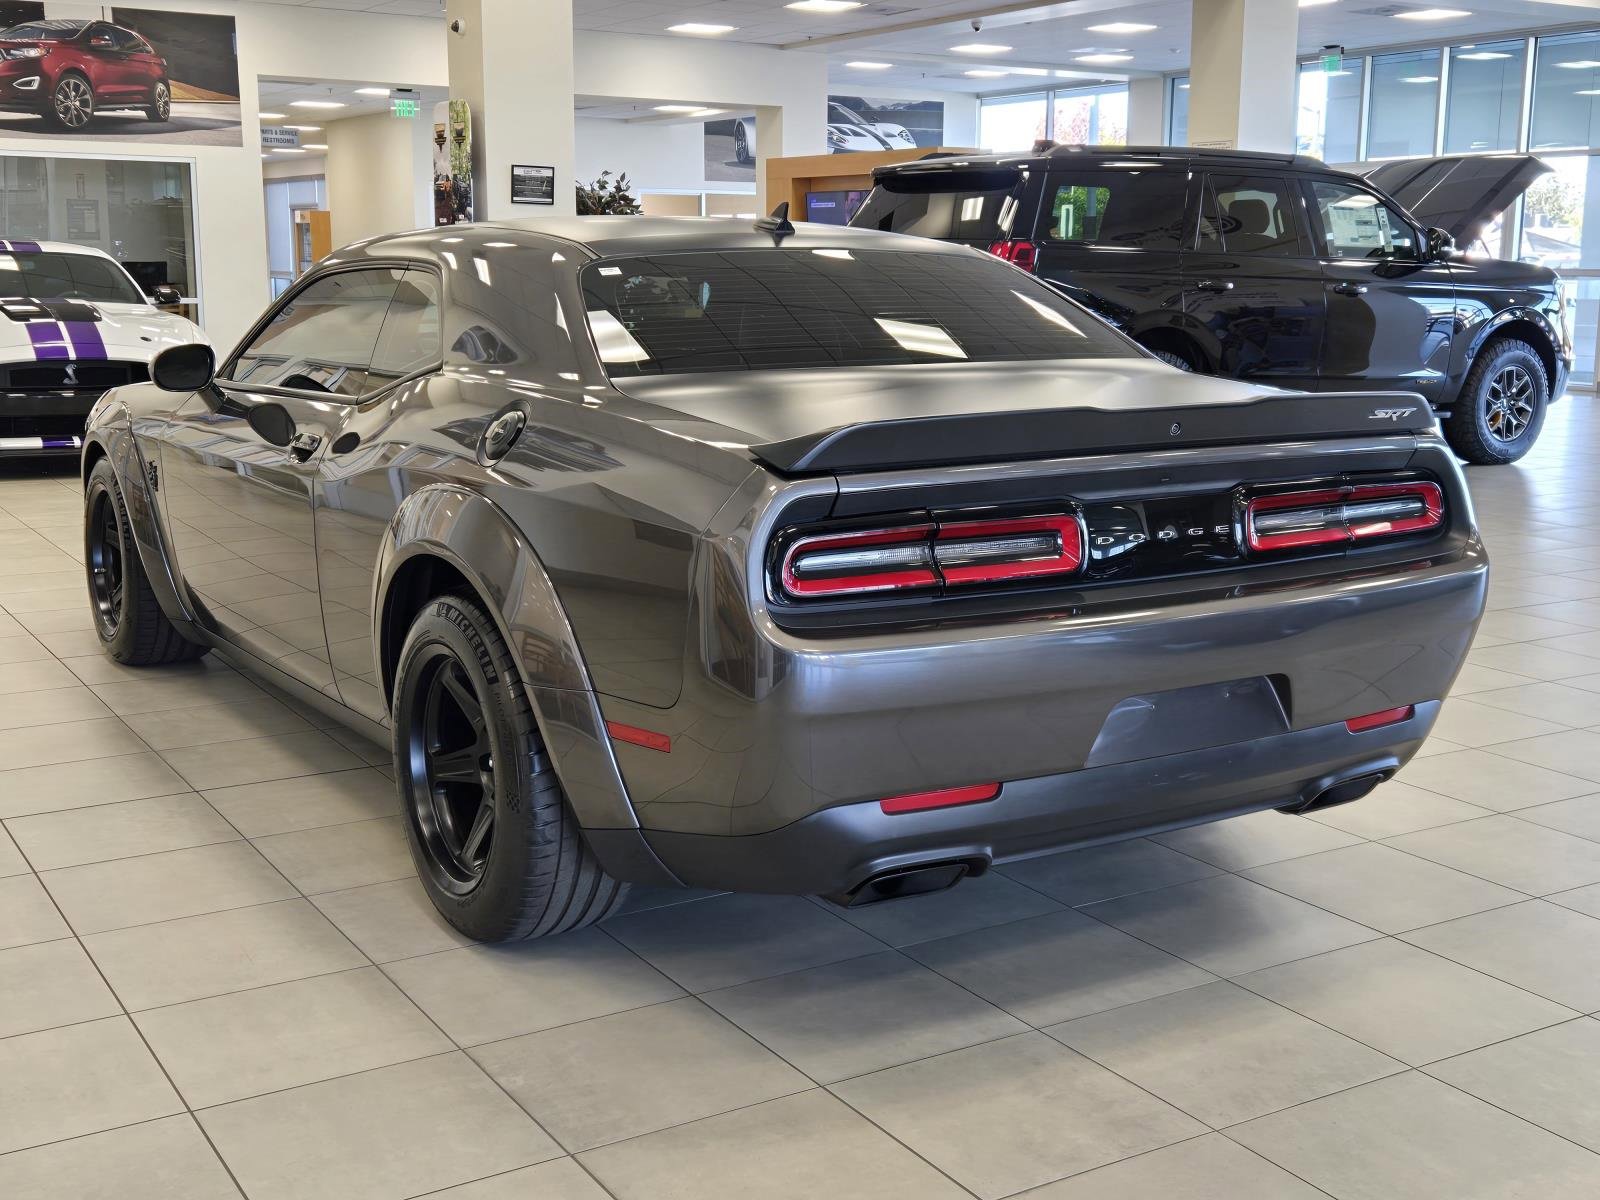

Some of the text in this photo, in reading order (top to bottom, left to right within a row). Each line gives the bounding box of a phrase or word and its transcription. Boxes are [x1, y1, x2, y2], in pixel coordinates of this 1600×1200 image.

[279, 129, 298, 137] SERVICE
[262, 136, 295, 145] RESTROOMS
[1368, 407, 1418, 421] SRT
[1096, 525, 1230, 545] DODGE
[447, 607, 497, 679] MICHELIN
